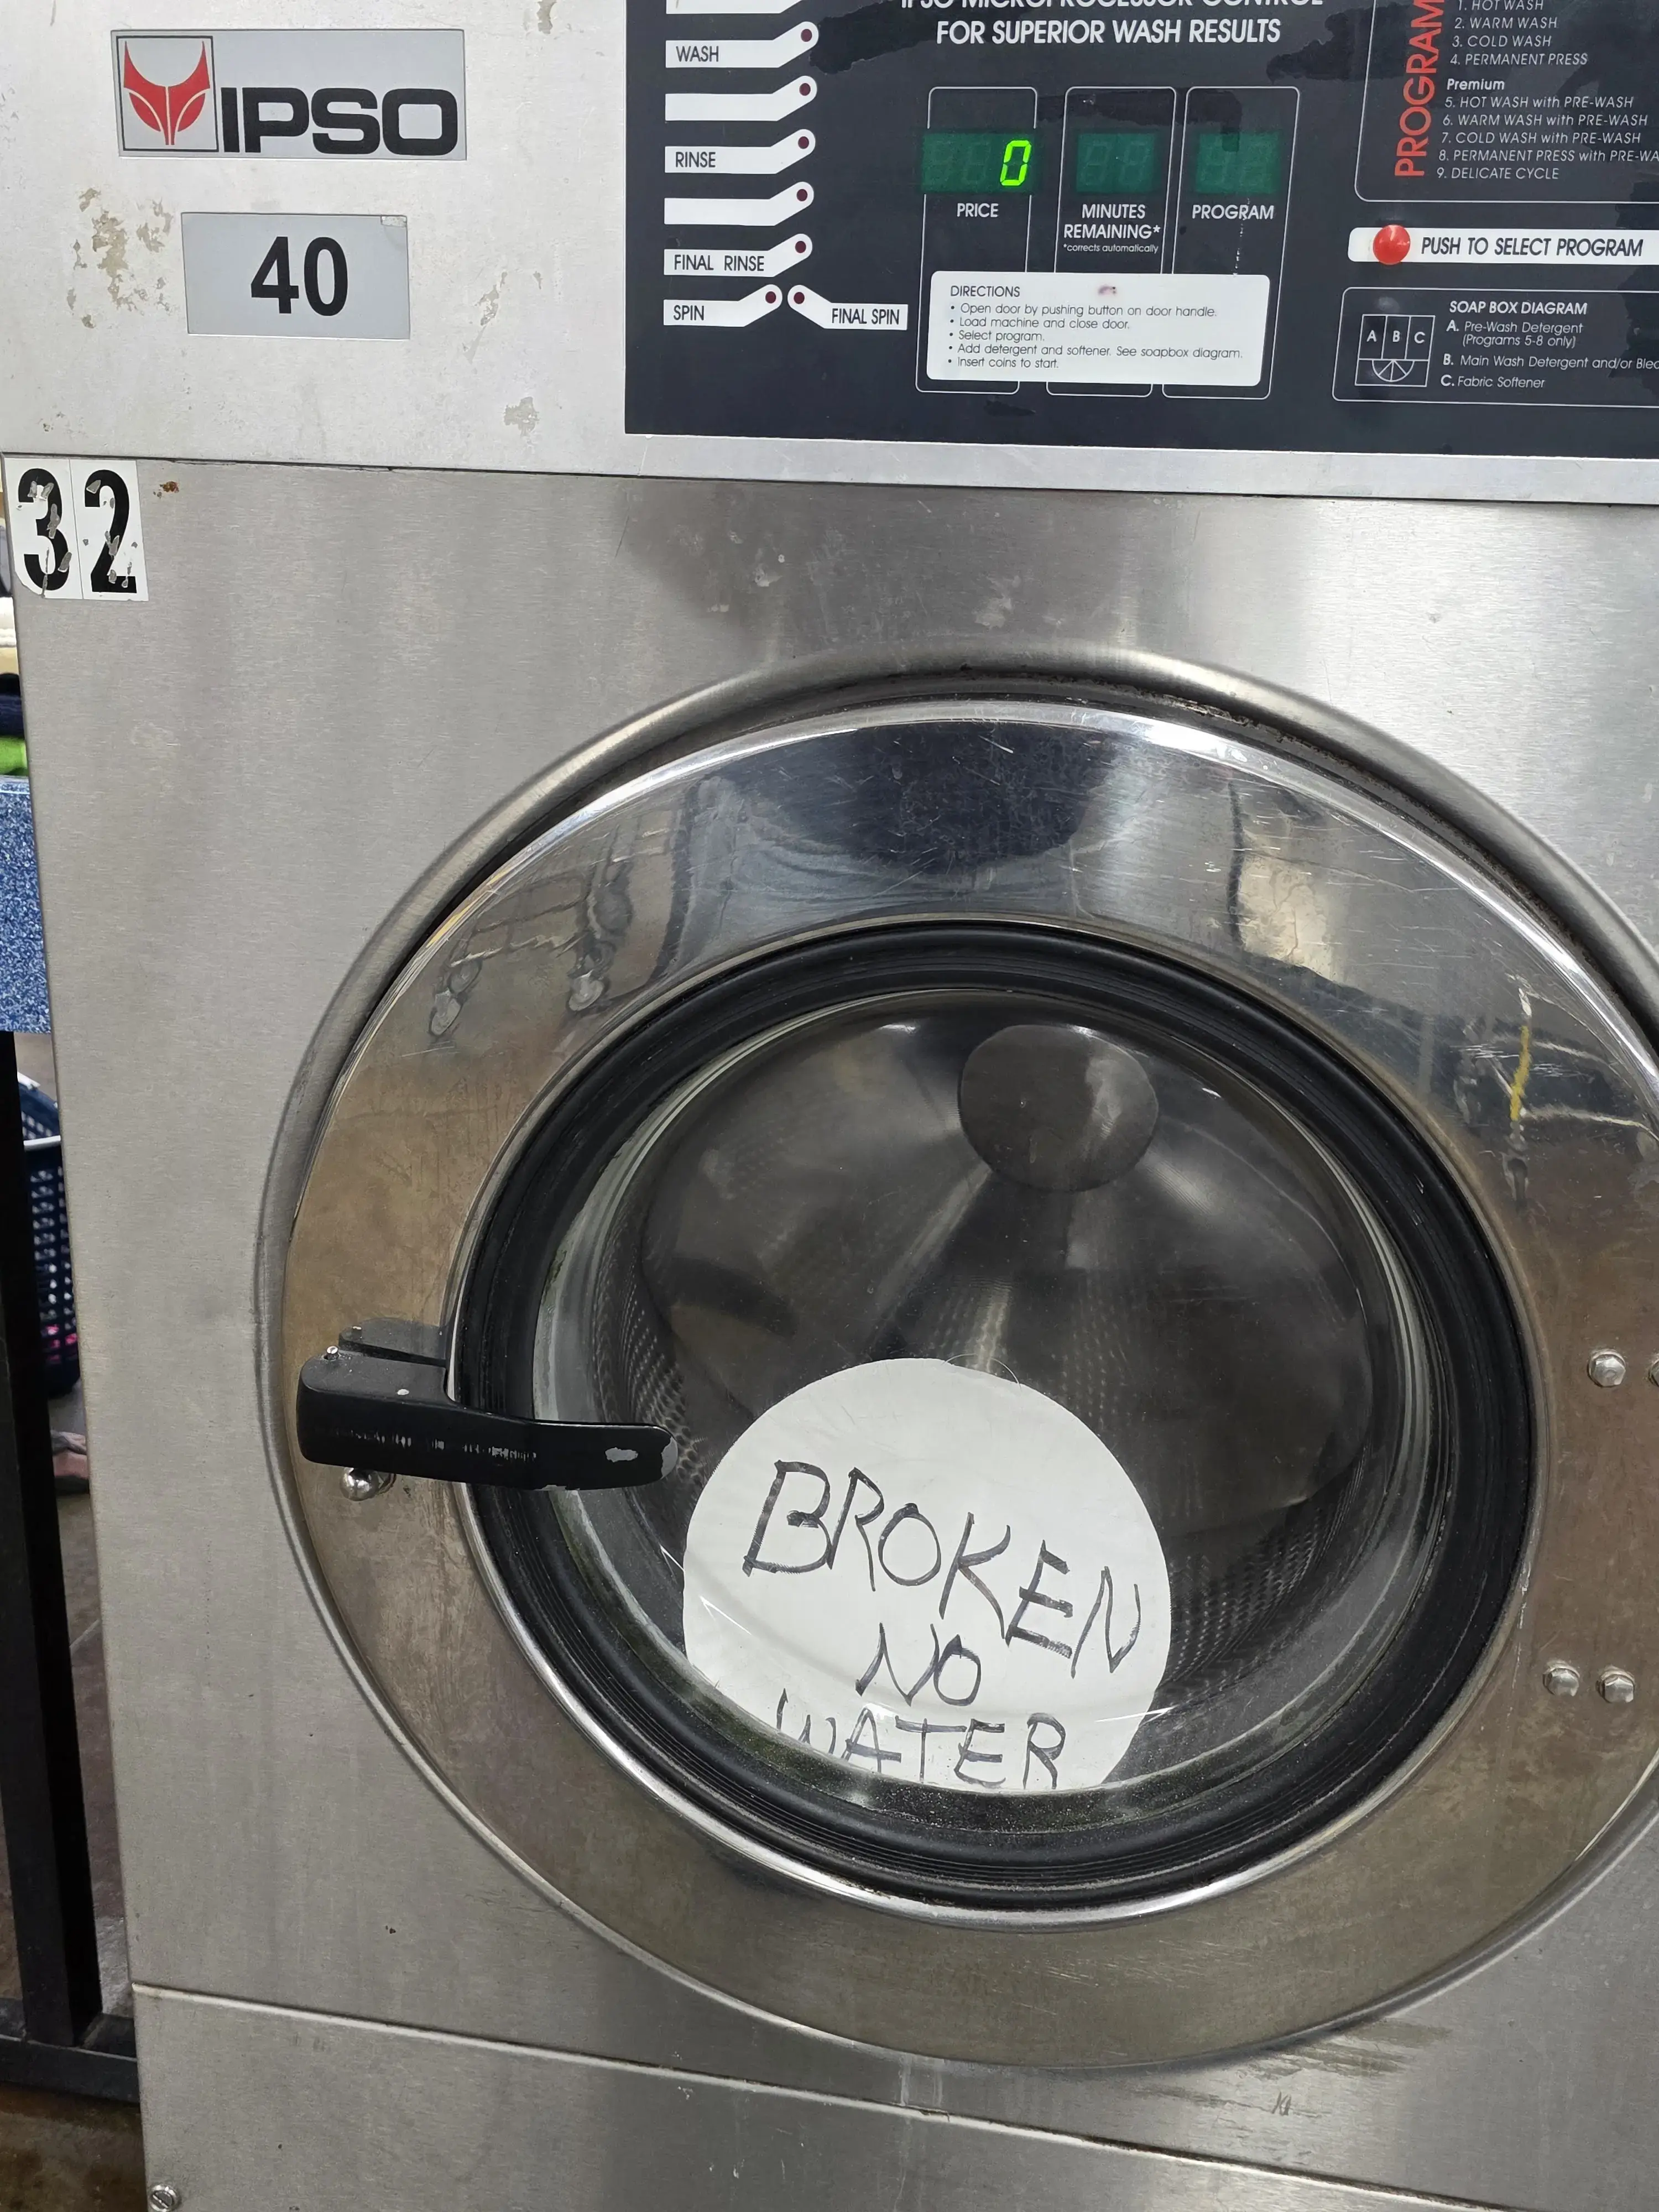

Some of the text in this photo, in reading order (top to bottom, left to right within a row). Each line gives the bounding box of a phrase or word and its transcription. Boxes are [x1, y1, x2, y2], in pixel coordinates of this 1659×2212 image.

[1458, 0, 1543, 11] 1. HOT WASH
[1454, 17, 1557, 29] 2. WARM WASH
[937, 19, 1280, 44] FOR SUPERIOR WASH RESULTS
[1452, 35, 1552, 47] 3. COLD WASH
[676, 46, 719, 62] WASH
[1450, 53, 1588, 65] 4. PERMANENT PRESS
[1447, 78, 1504, 90] Premium
[1445, 96, 1634, 108] 5. HOT WASH with PRE-WASH
[221, 87, 458, 156] IPSO
[1443, 114, 1648, 126] 6. WARM WASH with PRE-WASH
[1441, 132, 1641, 144] 7. COLD WASH with PRE-WASH
[675, 152, 716, 168] RINSE
[1000, 140, 1032, 186] 0
[1438, 150, 1449, 161] 8.
[1453, 150, 1533, 161] PERMANENT
[1537, 150, 1575, 161] PRESS
[1579, 150, 1605, 161] with
[1437, 168, 1559, 179] 9. DELICATE CYCLE
[957, 203, 999, 218] PRICE
[1082, 204, 1146, 219] MINUTES
[1192, 204, 1275, 220] PROGRAM
[1102, 244, 1159, 254] automatically
[1421, 237, 1644, 257] PUSH TO SELECT PROGRAM
[674, 254, 764, 272] FINAL RINSE
[251, 236, 348, 316] 40
[950, 285, 1020, 298] DIRECTIONS
[673, 305, 705, 321] SPIN
[961, 303, 1217, 317] Open door by pushing button on door handle.
[1449, 300, 1587, 316] SOAP BOX DIAGRAM
[832, 309, 899, 325] FINAL SPIN
[959, 317, 1129, 329] Load machine and close door.
[1446, 320, 1583, 336] A. Pre-Wash Detergent
[958, 330, 1045, 343] Select program.
[1366, 330, 1376, 342] A
[1392, 331, 1400, 342] B
[1414, 332, 1425, 343] C
[1462, 334, 1576, 349] (Programs 5-8 only)
[957, 343, 1243, 361] Add detergent and softener. See soapbox diagram.
[958, 357, 1058, 368] Insert coins to start.
[1443, 354, 1454, 366] B.
[1460, 355, 1489, 367] Main
[1493, 356, 1524, 367] Wash
[1528, 356, 1588, 370] Detergent
[1592, 357, 1632, 369] and/or
[1441, 374, 1545, 389] C. Fabric Softener
[18, 468, 137, 593] 32
[742, 1459, 1142, 1679] BROKEN
[855, 1622, 982, 1706] NO
